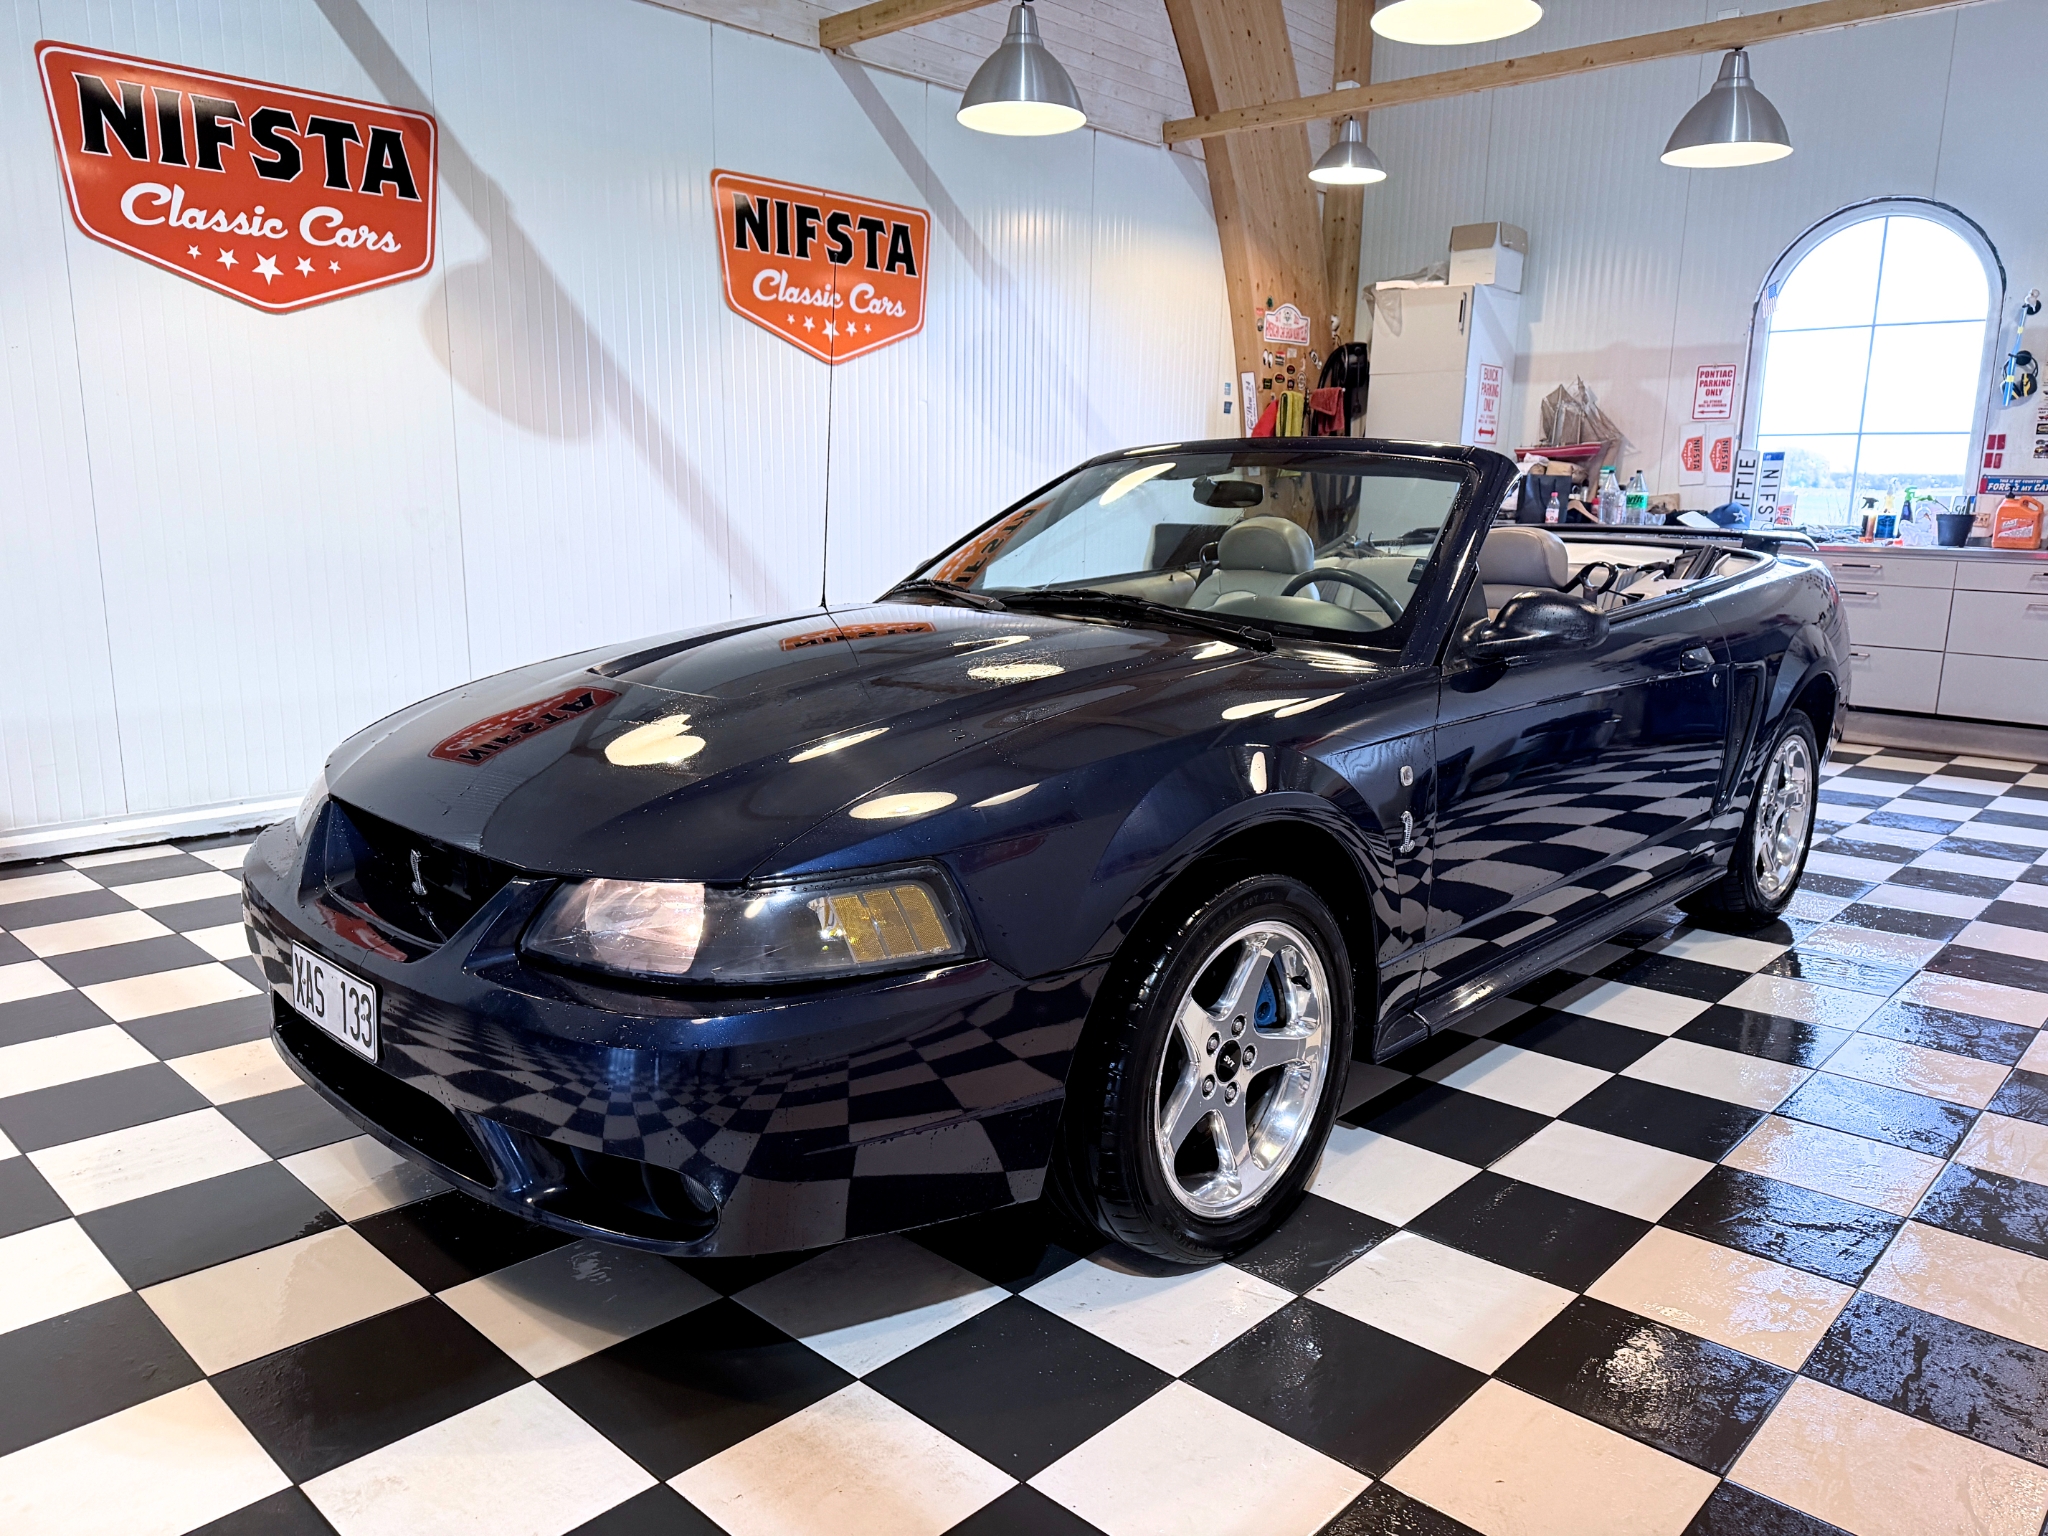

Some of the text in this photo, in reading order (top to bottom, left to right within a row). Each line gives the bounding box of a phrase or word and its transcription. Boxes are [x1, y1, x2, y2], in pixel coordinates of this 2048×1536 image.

[71, 72, 422, 203] NIFSTA
[120, 182, 402, 254] Classic Cars
[732, 192, 919, 278] NIFSTA
[752, 268, 906, 318] Classic Cars
[1484, 368, 1498, 382] BUICK
[1699, 369, 1733, 379] PONTIAC
[1481, 382, 1499, 397] PARKING
[1699, 379, 1731, 388] PARKING
[1705, 388, 1723, 397] ONLY
[1484, 398, 1494, 412] ONLY
[1721, 440, 1729, 470] NIFSTA
[294, 952, 372, 1048] XAS 133
[1223, 1055, 1236, 1068] SVT
